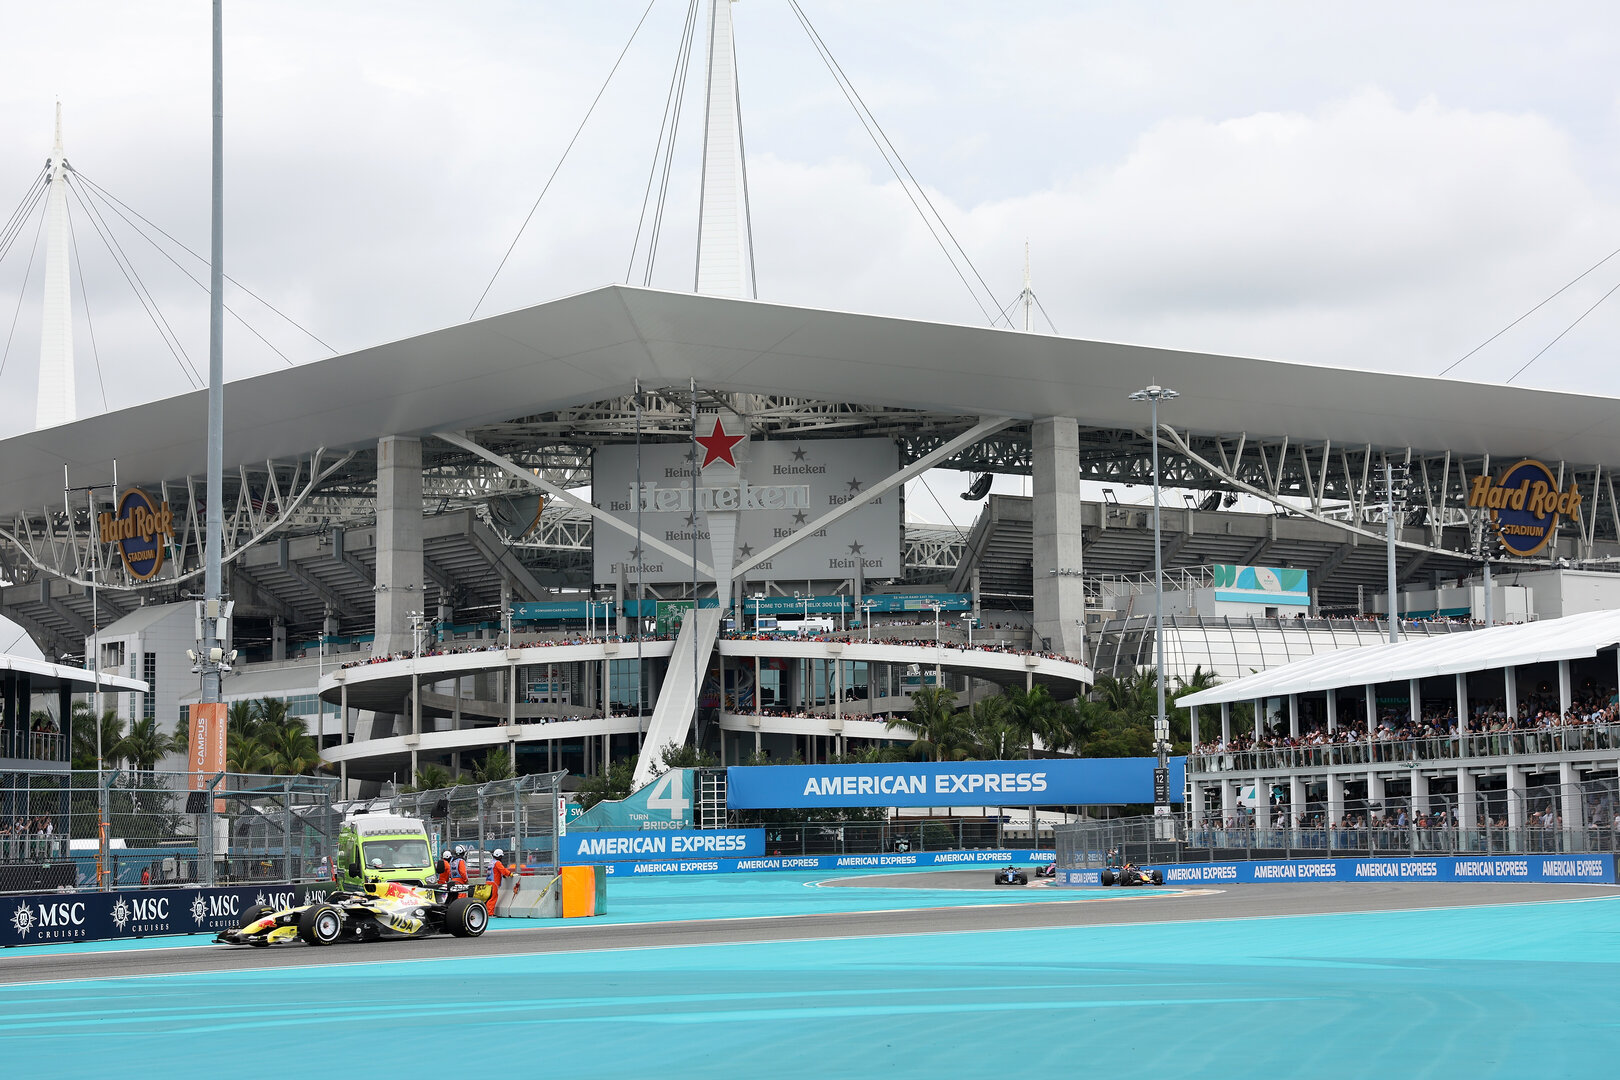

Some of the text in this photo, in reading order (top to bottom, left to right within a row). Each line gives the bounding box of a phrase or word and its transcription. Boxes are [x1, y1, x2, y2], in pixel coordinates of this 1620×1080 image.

[665, 467, 702, 477] Heink
[773, 464, 826, 475] Heineken
[629, 479, 809, 513] Heineken
[1468, 475, 1582, 522] Hard Rock
[98, 501, 175, 544] Hard Rock
[665, 530, 710, 541] Heinke
[1503, 524, 1544, 537] STADIUM
[127, 549, 155, 563] STADIUM
[829, 558, 883, 568] Heinken
[610, 563, 663, 574] Hineken
[197, 718, 205, 766] CAMPUS
[803, 772, 1047, 796] AMERICAN EXPRESS
[1156, 774, 1164, 783] 12
[647, 769, 689, 820] 4
[643, 821, 683, 830] BRIDGE
[577, 835, 746, 855] AMERICAN EXPRESS
[836, 855, 917, 866] AMERICAN EXPRESS
[934, 852, 1012, 863] AMERICAN EXPRESS
[1029, 852, 1056, 861] AMERI
[634, 861, 718, 873] AMERICAN EXPRESS
[737, 858, 819, 870] AMERICAN EXPRESS
[1254, 863, 1336, 878] AMERICAN EXPRESS
[1355, 862, 1437, 877] AMERICAN EXPRESS
[1454, 861, 1528, 876] AMERICAN EXPRESS
[1542, 860, 1603, 876] AMERICAN EXPRESS
[1167, 866, 1237, 881] AMERICAN EXPRESS
[209, 894, 240, 917] MSC
[268, 891, 295, 912] MSC
[38, 902, 86, 927] MSC
[132, 897, 169, 921] MSC
[132, 923, 169, 932] CRUISES
[209, 919, 240, 928] CRUISES
[389, 913, 414, 932] VISA
[38, 928, 86, 939] CRUISES
